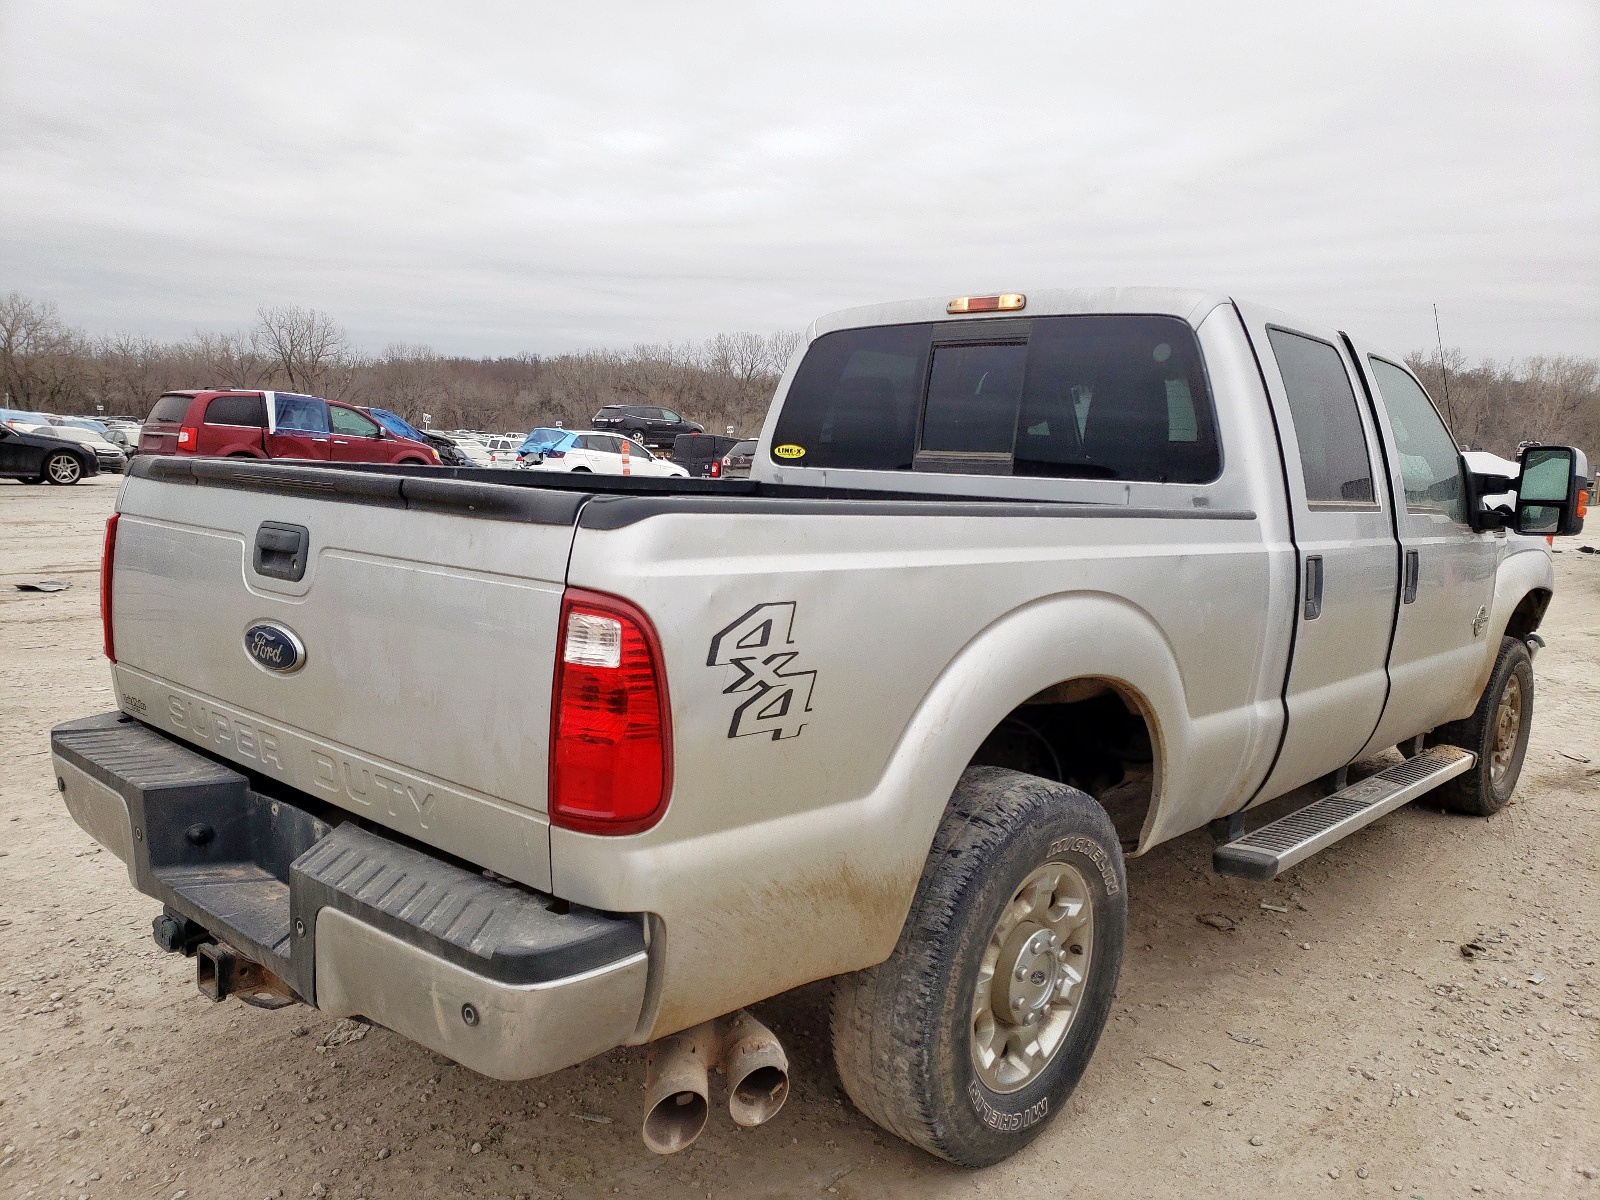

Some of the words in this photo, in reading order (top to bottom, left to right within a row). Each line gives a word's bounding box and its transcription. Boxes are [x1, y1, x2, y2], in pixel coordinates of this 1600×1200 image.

[251, 631, 284, 663] Ford
[168, 694, 284, 771] SUPER
[310, 749, 436, 830] DUTY
[1046, 836, 1120, 896] MICHELIN
[968, 1079, 1049, 1131] MICHELIN
